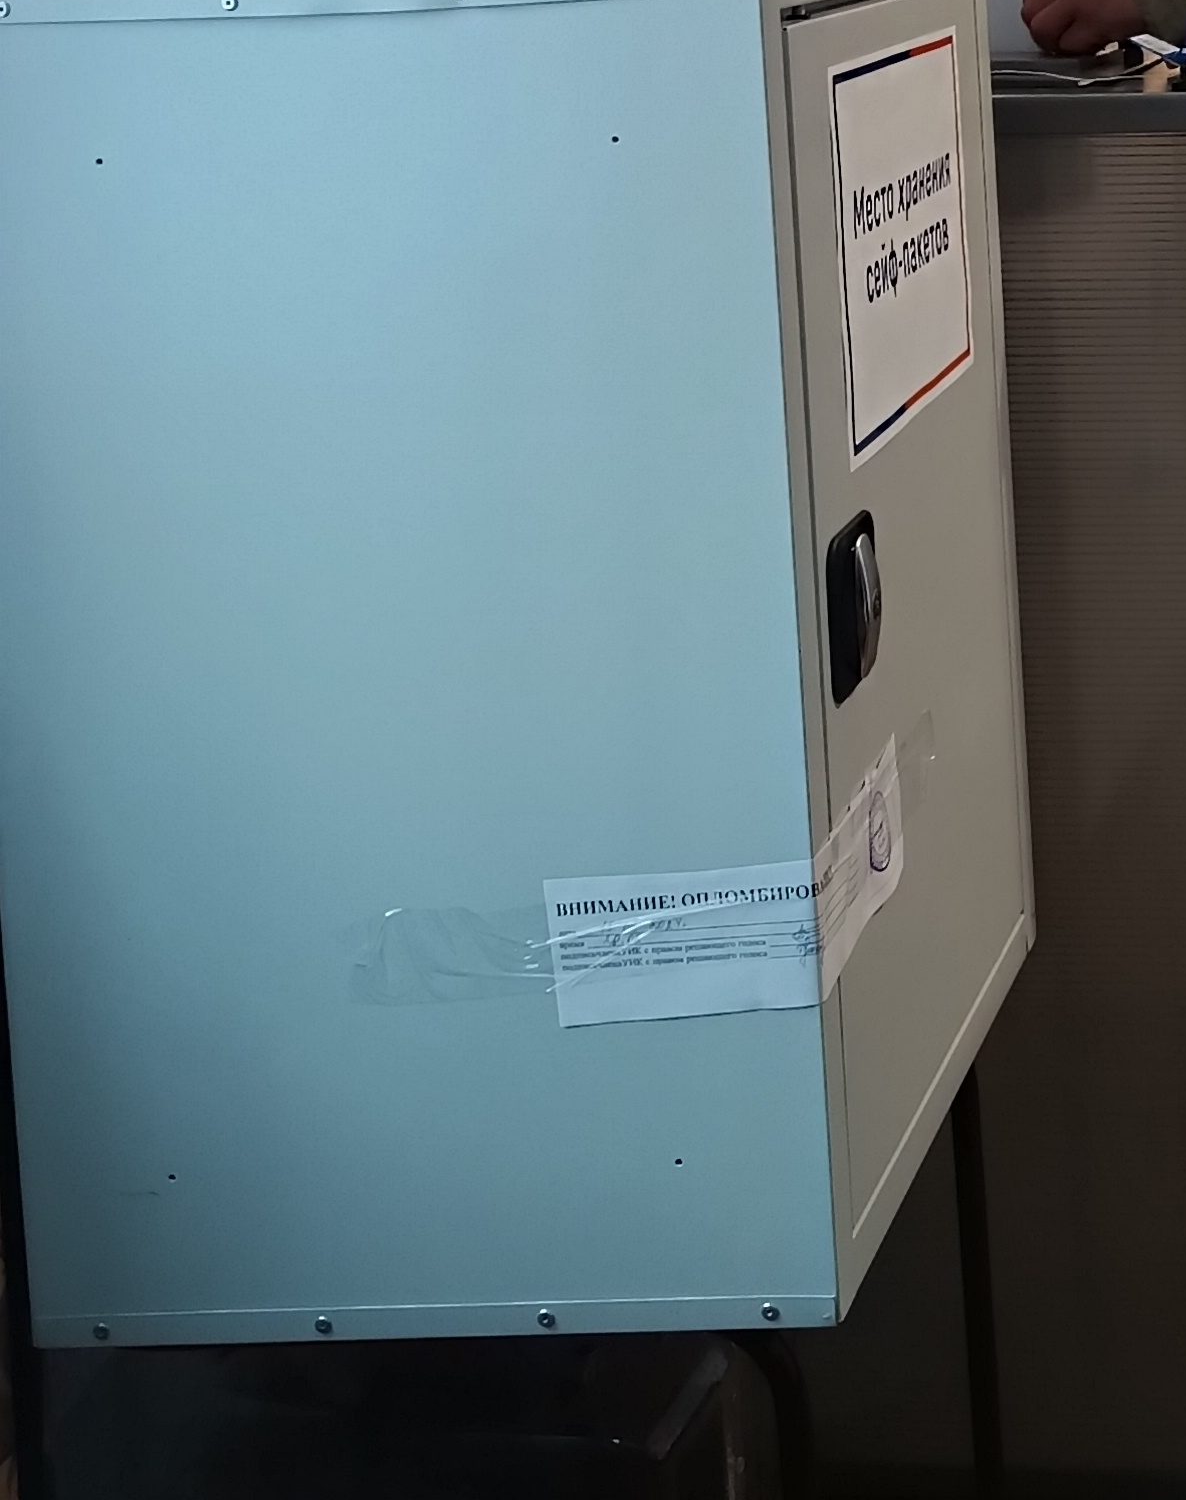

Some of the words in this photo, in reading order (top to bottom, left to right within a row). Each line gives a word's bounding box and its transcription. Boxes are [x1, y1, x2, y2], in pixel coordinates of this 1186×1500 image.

[854, 183, 894, 240] Место
[898, 152, 951, 221] хранения
[866, 218, 949, 303] сейф-пакетов
[556, 894, 676, 917] ВНИМАНИЕ!
